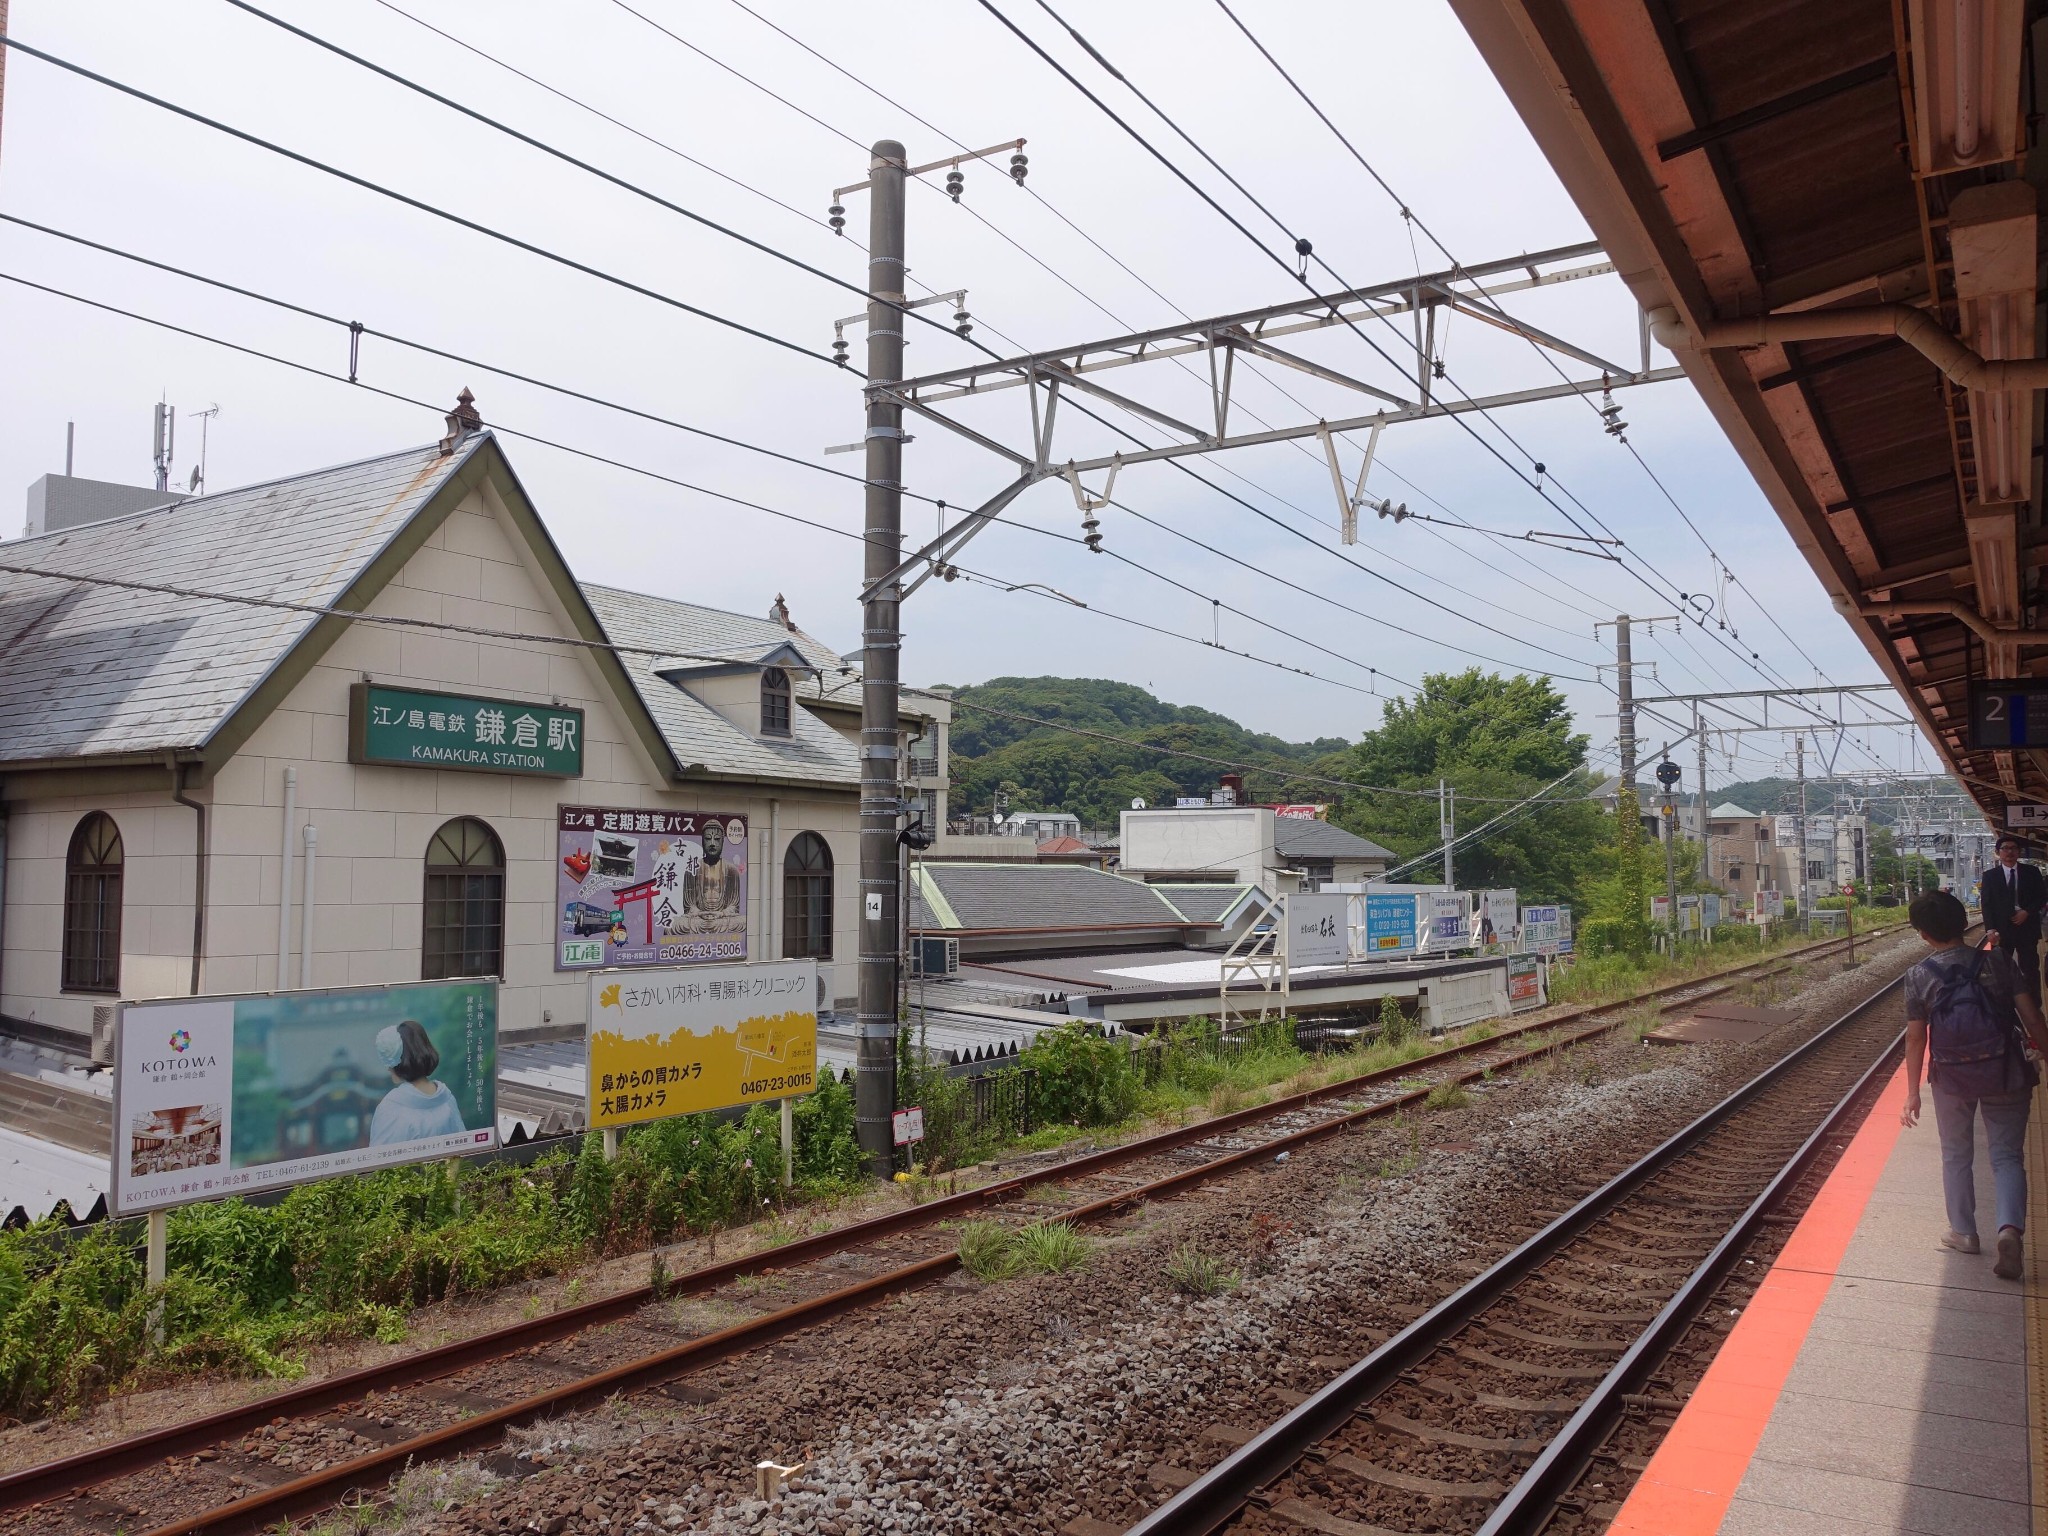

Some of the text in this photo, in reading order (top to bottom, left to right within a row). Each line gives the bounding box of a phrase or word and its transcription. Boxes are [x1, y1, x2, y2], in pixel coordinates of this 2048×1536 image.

[1986, 696, 2004, 721] 2
[373, 705, 576, 752] 江ノ島電鉄 鎌倉駅
[412, 745, 545, 768] KAMAKURA STATION
[565, 812, 696, 833] 江ノ電 定期遊覧バス
[653, 862, 679, 928] 鎌倉
[867, 902, 879, 911] 14
[669, 944, 741, 959] 0466-24-5006
[141, 1055, 217, 1074] KOTOWA
[152, 1075, 167, 1083] 鎌倉
[601, 1062, 703, 1093] 鼻からの胃カメラ
[741, 1073, 812, 1095] 0467-23-0015
[601, 1089, 667, 1116] 大腸カメラ
[126, 1188, 176, 1204] KOTOWA
[180, 1181, 199, 1194] 鎌倉
